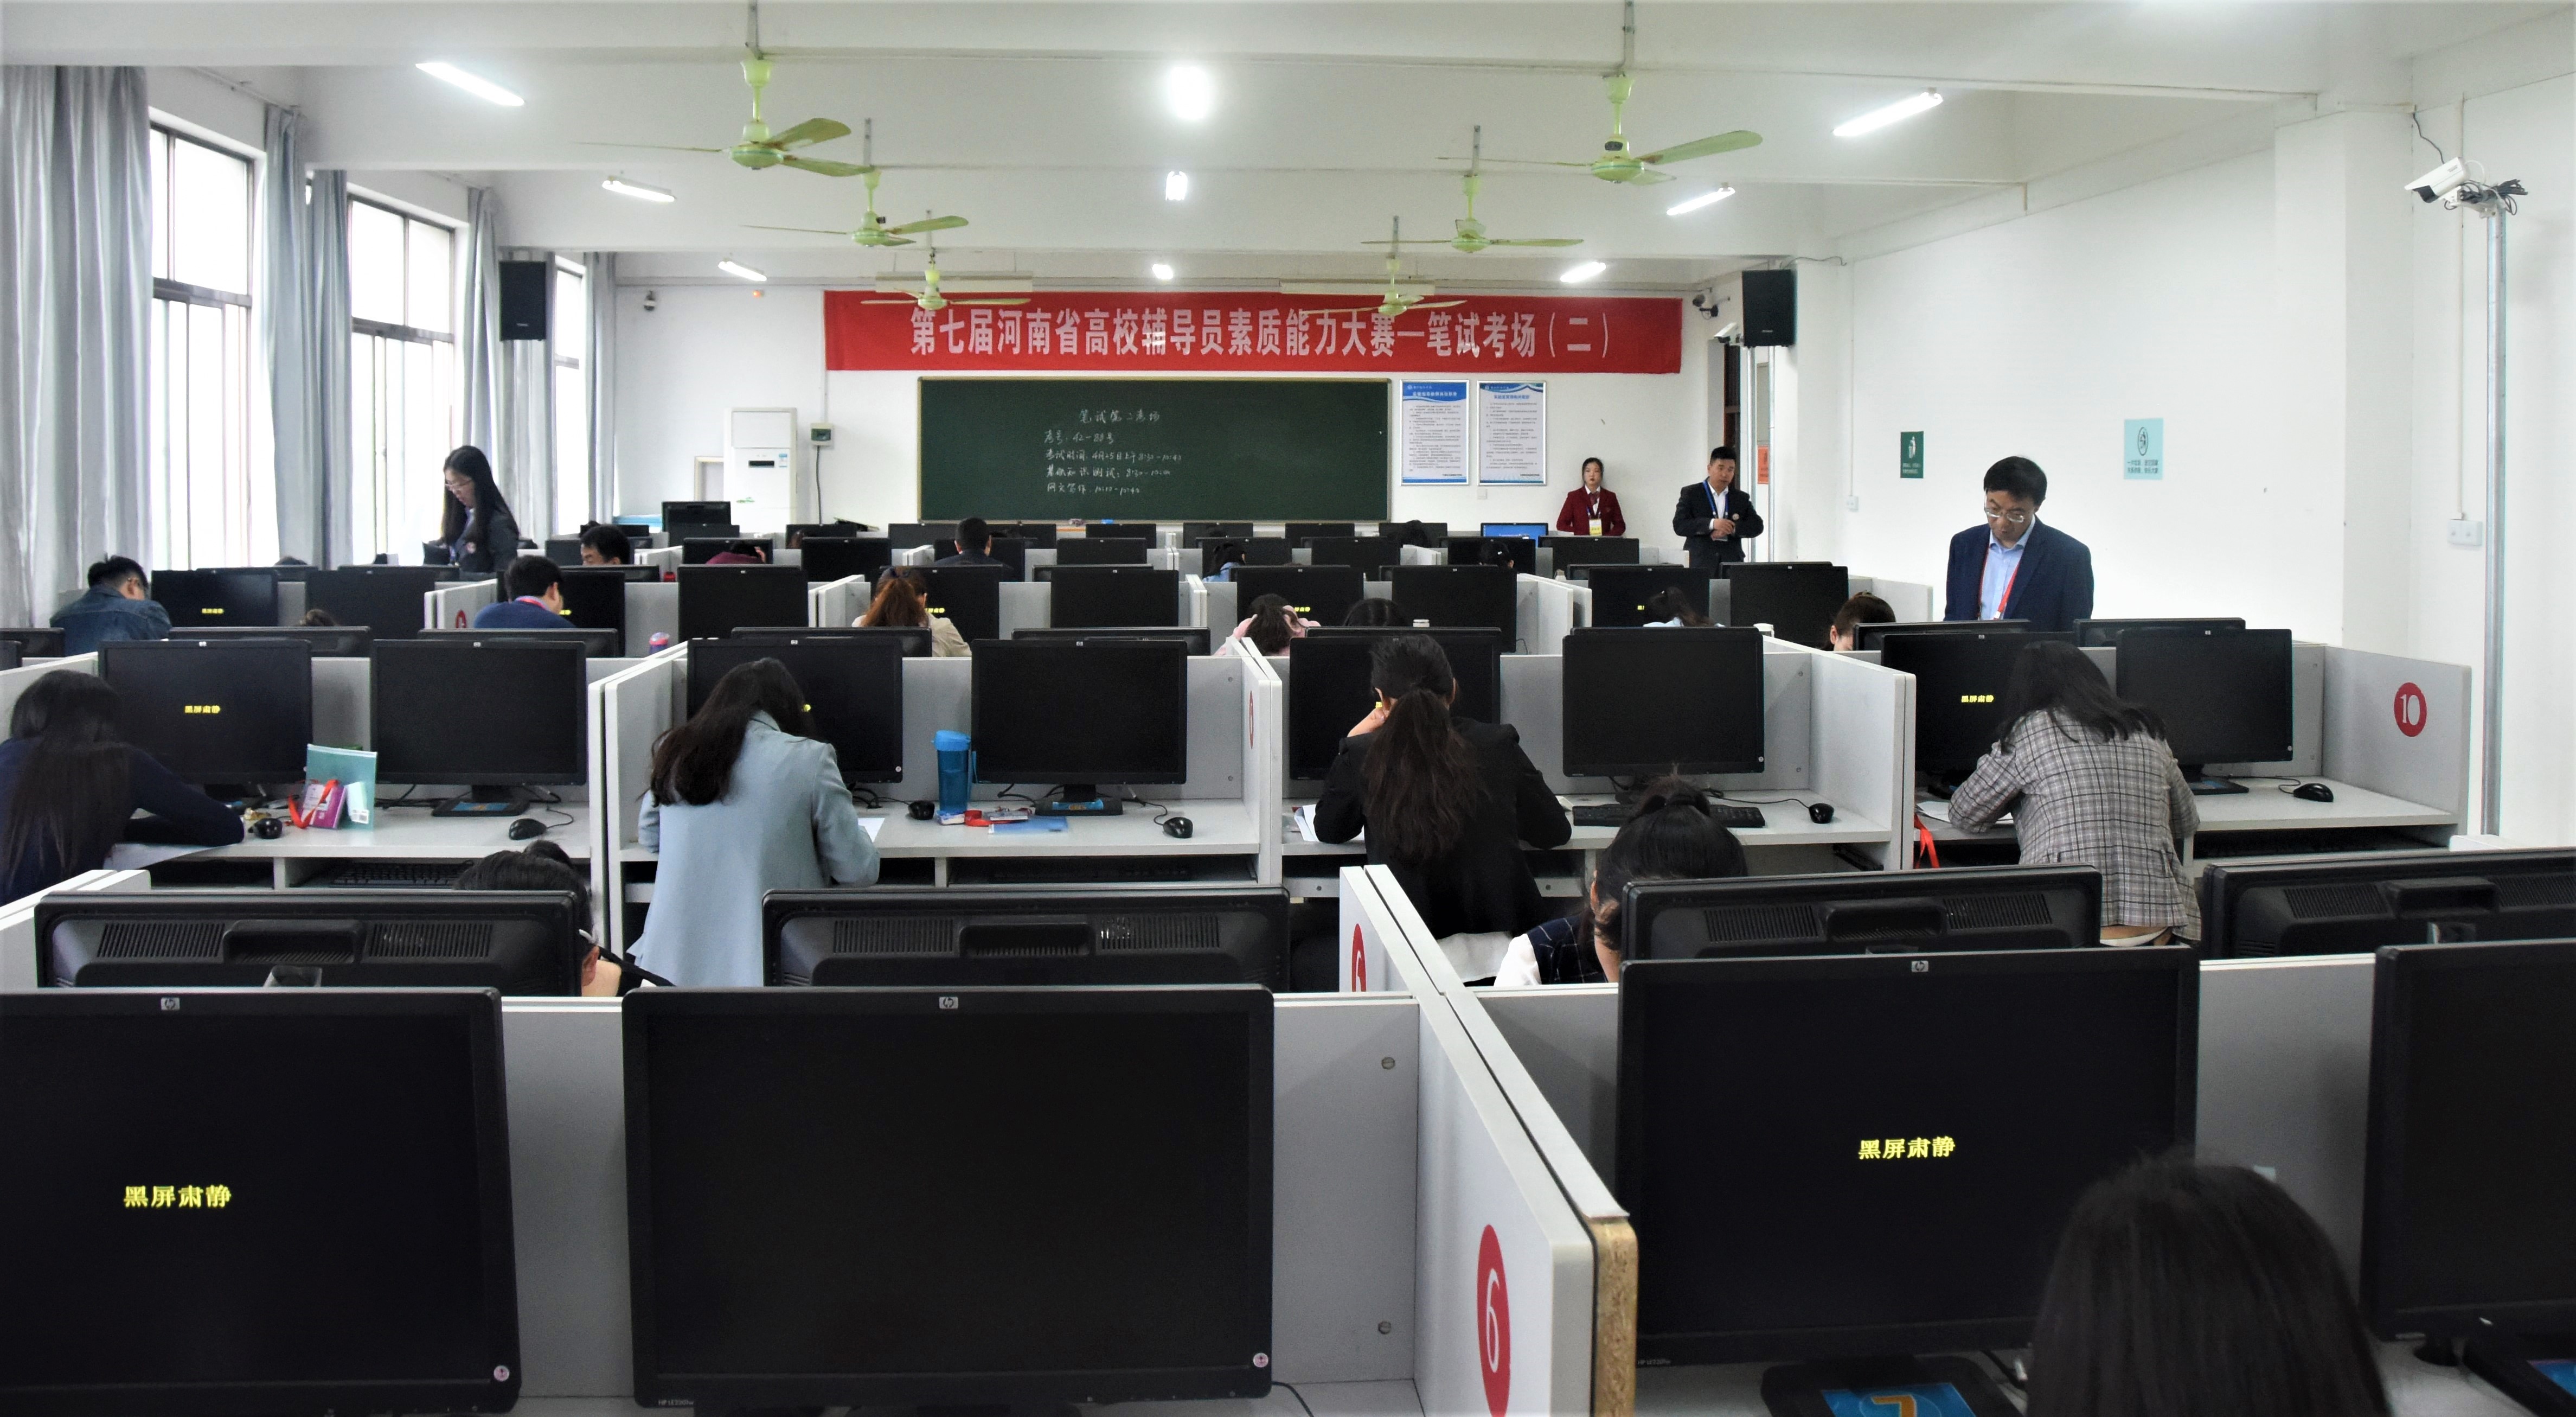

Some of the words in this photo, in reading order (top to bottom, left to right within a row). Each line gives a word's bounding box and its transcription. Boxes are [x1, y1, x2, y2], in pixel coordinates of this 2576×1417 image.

[2400, 694, 2420, 725] 10
[1858, 1135, 1956, 1160] 黑屏肃静
[124, 1184, 232, 1208] 黑屏肃静
[1486, 1267, 1500, 1374] 6
